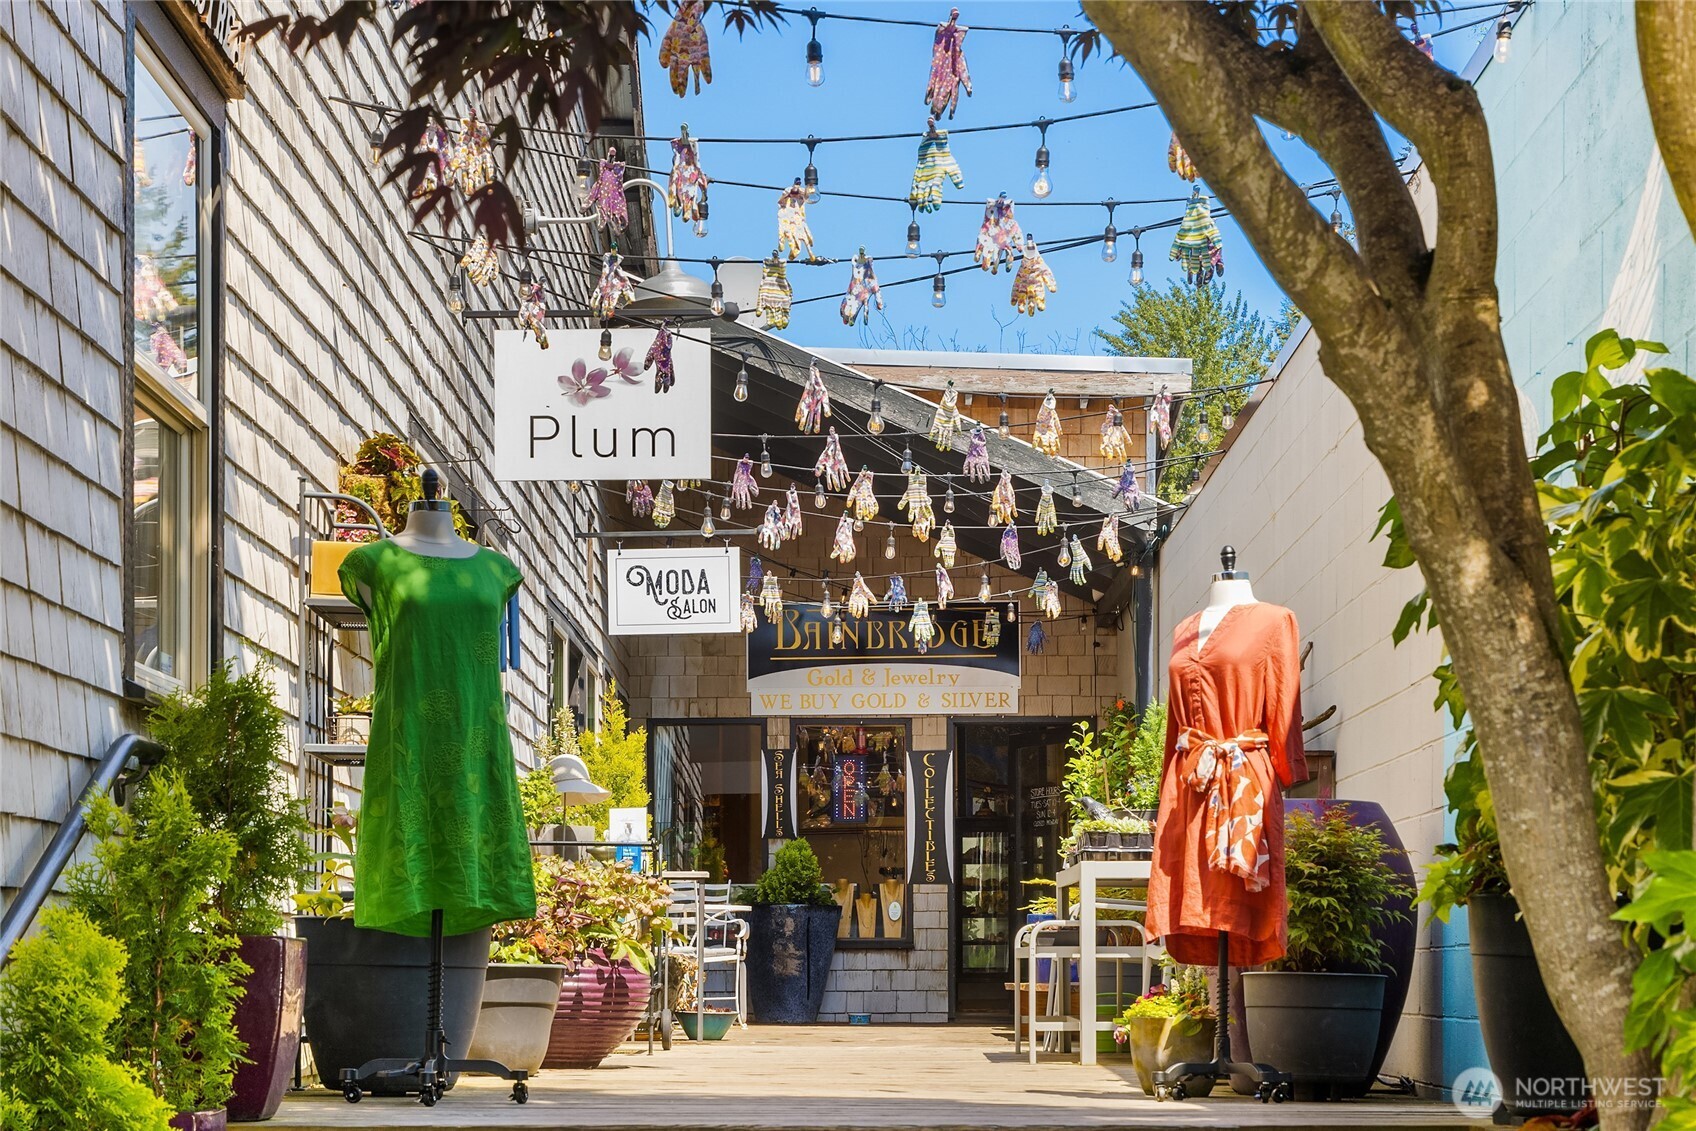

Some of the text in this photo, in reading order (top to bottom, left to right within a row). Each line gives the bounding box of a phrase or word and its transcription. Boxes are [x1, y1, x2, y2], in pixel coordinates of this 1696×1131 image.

[529, 414, 676, 458] Plum
[625, 565, 710, 606] MODA
[667, 596, 717, 620] SALON
[807, 667, 961, 688] Gold & Jewelry
[759, 691, 1011, 710] WE BUY GOLD & SILVER
[843, 760, 857, 817] OPEN
[923, 752, 936, 883] COLLECTIBLES
